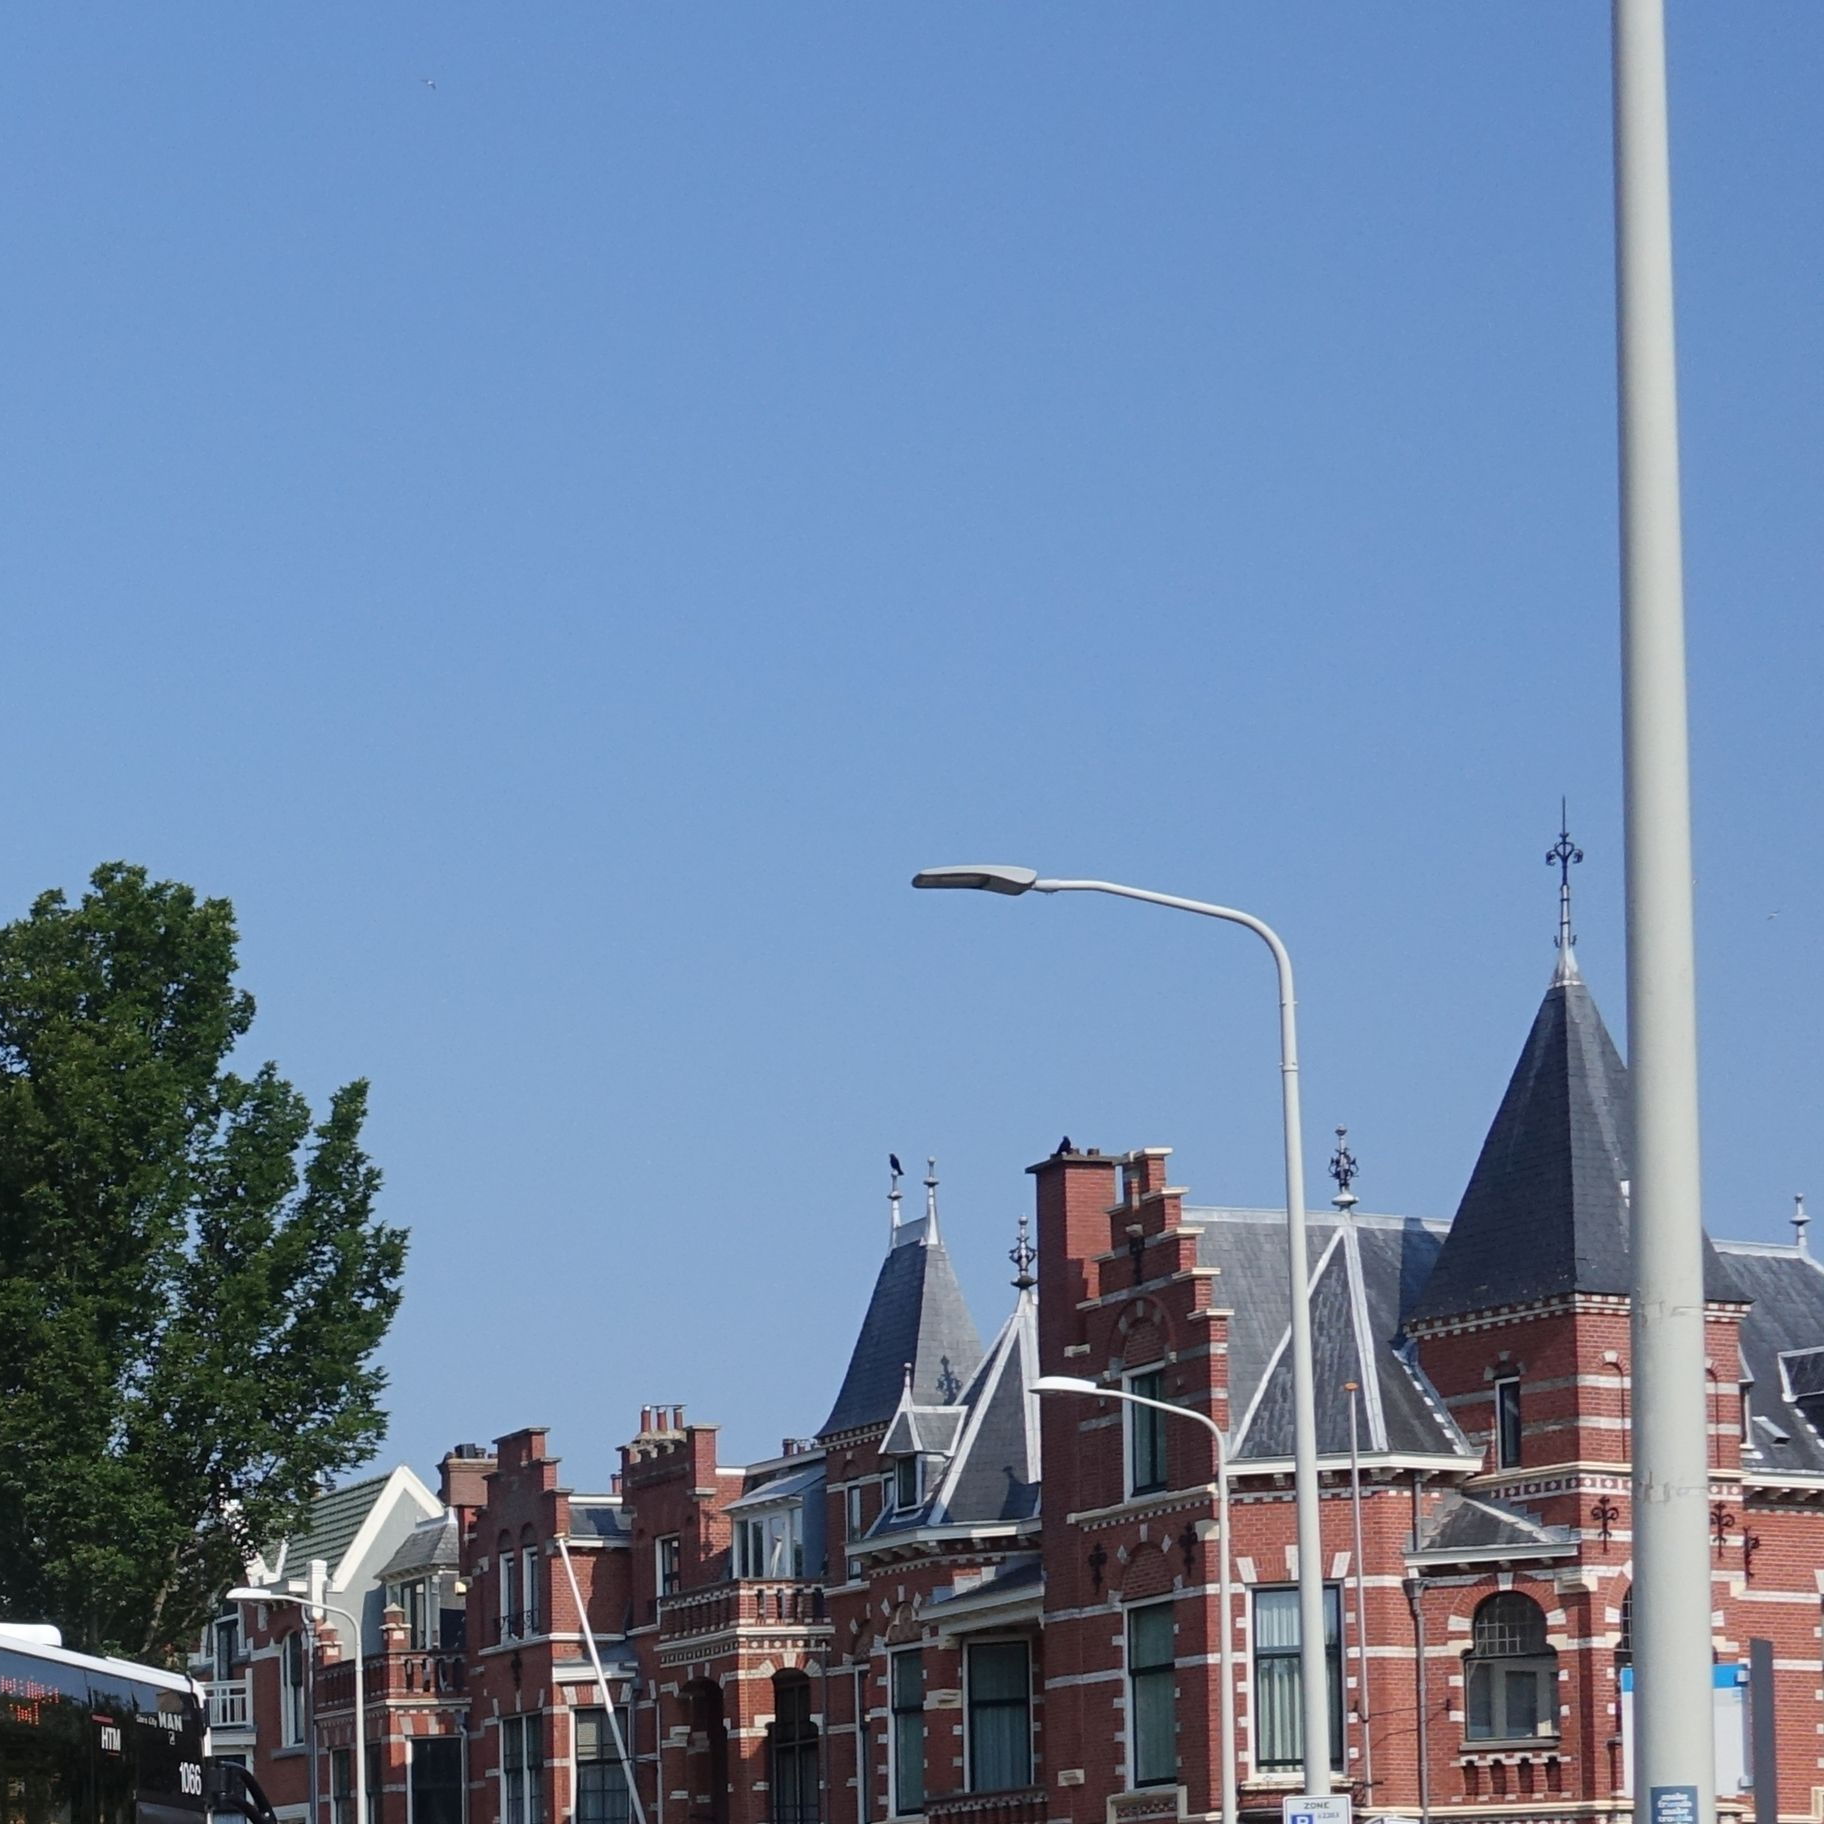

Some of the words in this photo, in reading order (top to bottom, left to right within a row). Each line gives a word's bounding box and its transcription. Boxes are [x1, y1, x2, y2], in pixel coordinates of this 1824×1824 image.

[158, 1710, 183, 1733] MAN
[101, 1725, 121, 1752] HTM
[179, 1761, 202, 1796] 1066
[1303, 1801, 1330, 1810] ZONE
